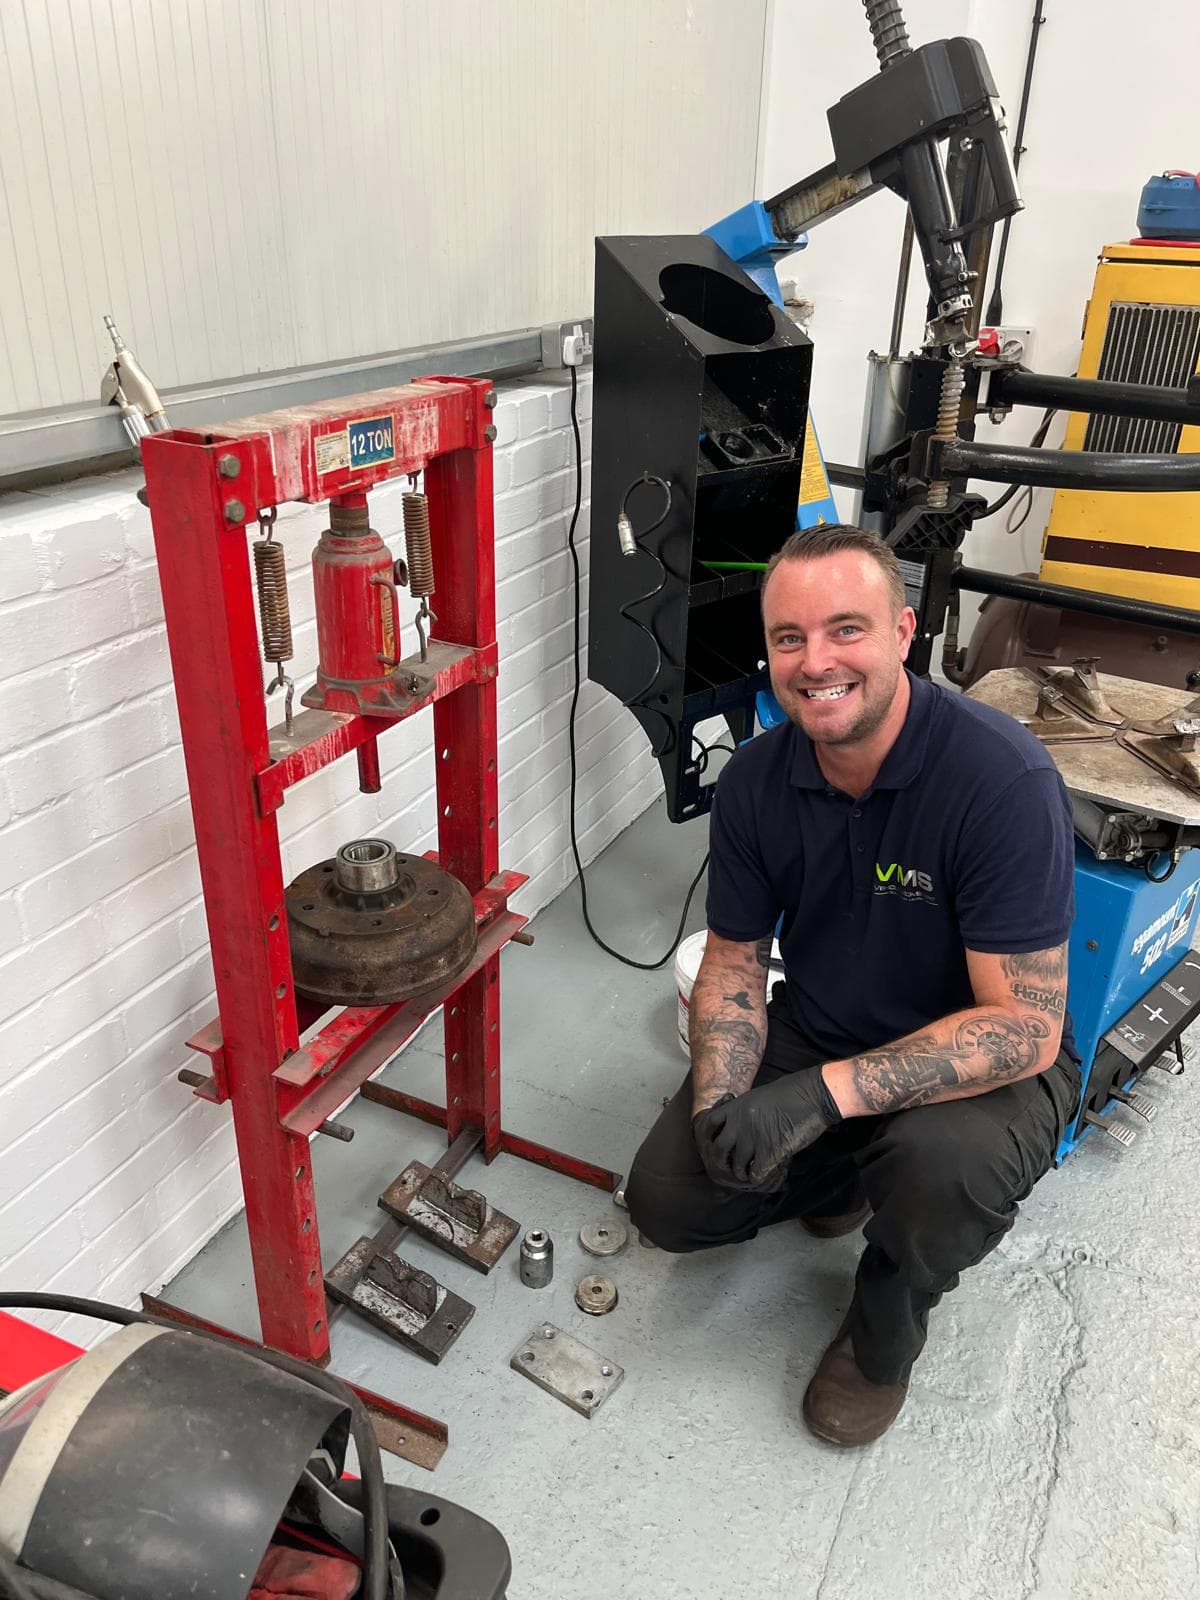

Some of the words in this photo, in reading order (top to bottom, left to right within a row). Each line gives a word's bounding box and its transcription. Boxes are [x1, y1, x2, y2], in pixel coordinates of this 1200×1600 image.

[352, 433, 366, 456] 12
[367, 428, 392, 452] TON
[875, 863, 934, 892] VMS
